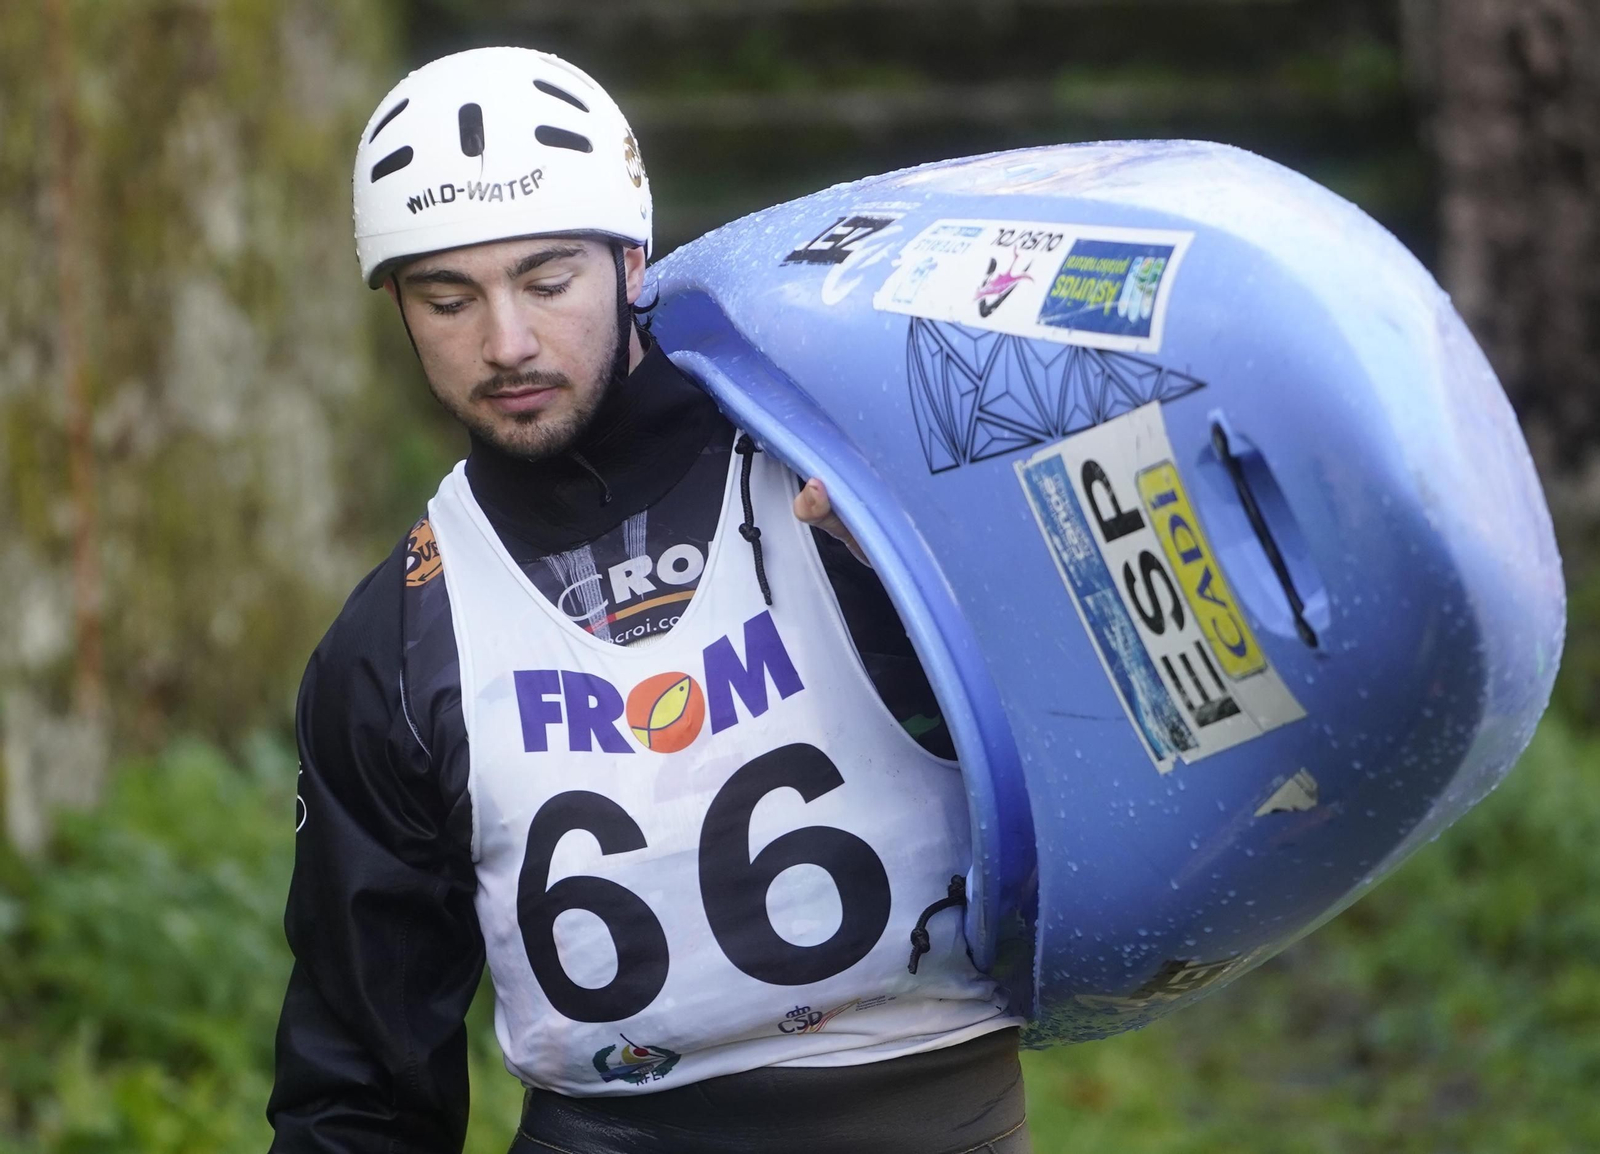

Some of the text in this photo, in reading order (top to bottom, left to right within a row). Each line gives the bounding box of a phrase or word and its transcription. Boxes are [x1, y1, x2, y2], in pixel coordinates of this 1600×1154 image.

[1050, 273, 1122, 316] Asturias
[557, 541, 715, 622] CRO
[1081, 459, 1242, 729] ESP
[1150, 489, 1248, 660] CADI
[513, 609, 805, 754] FROM
[516, 742, 892, 1023] 66
[777, 1010, 823, 1034] CSD
